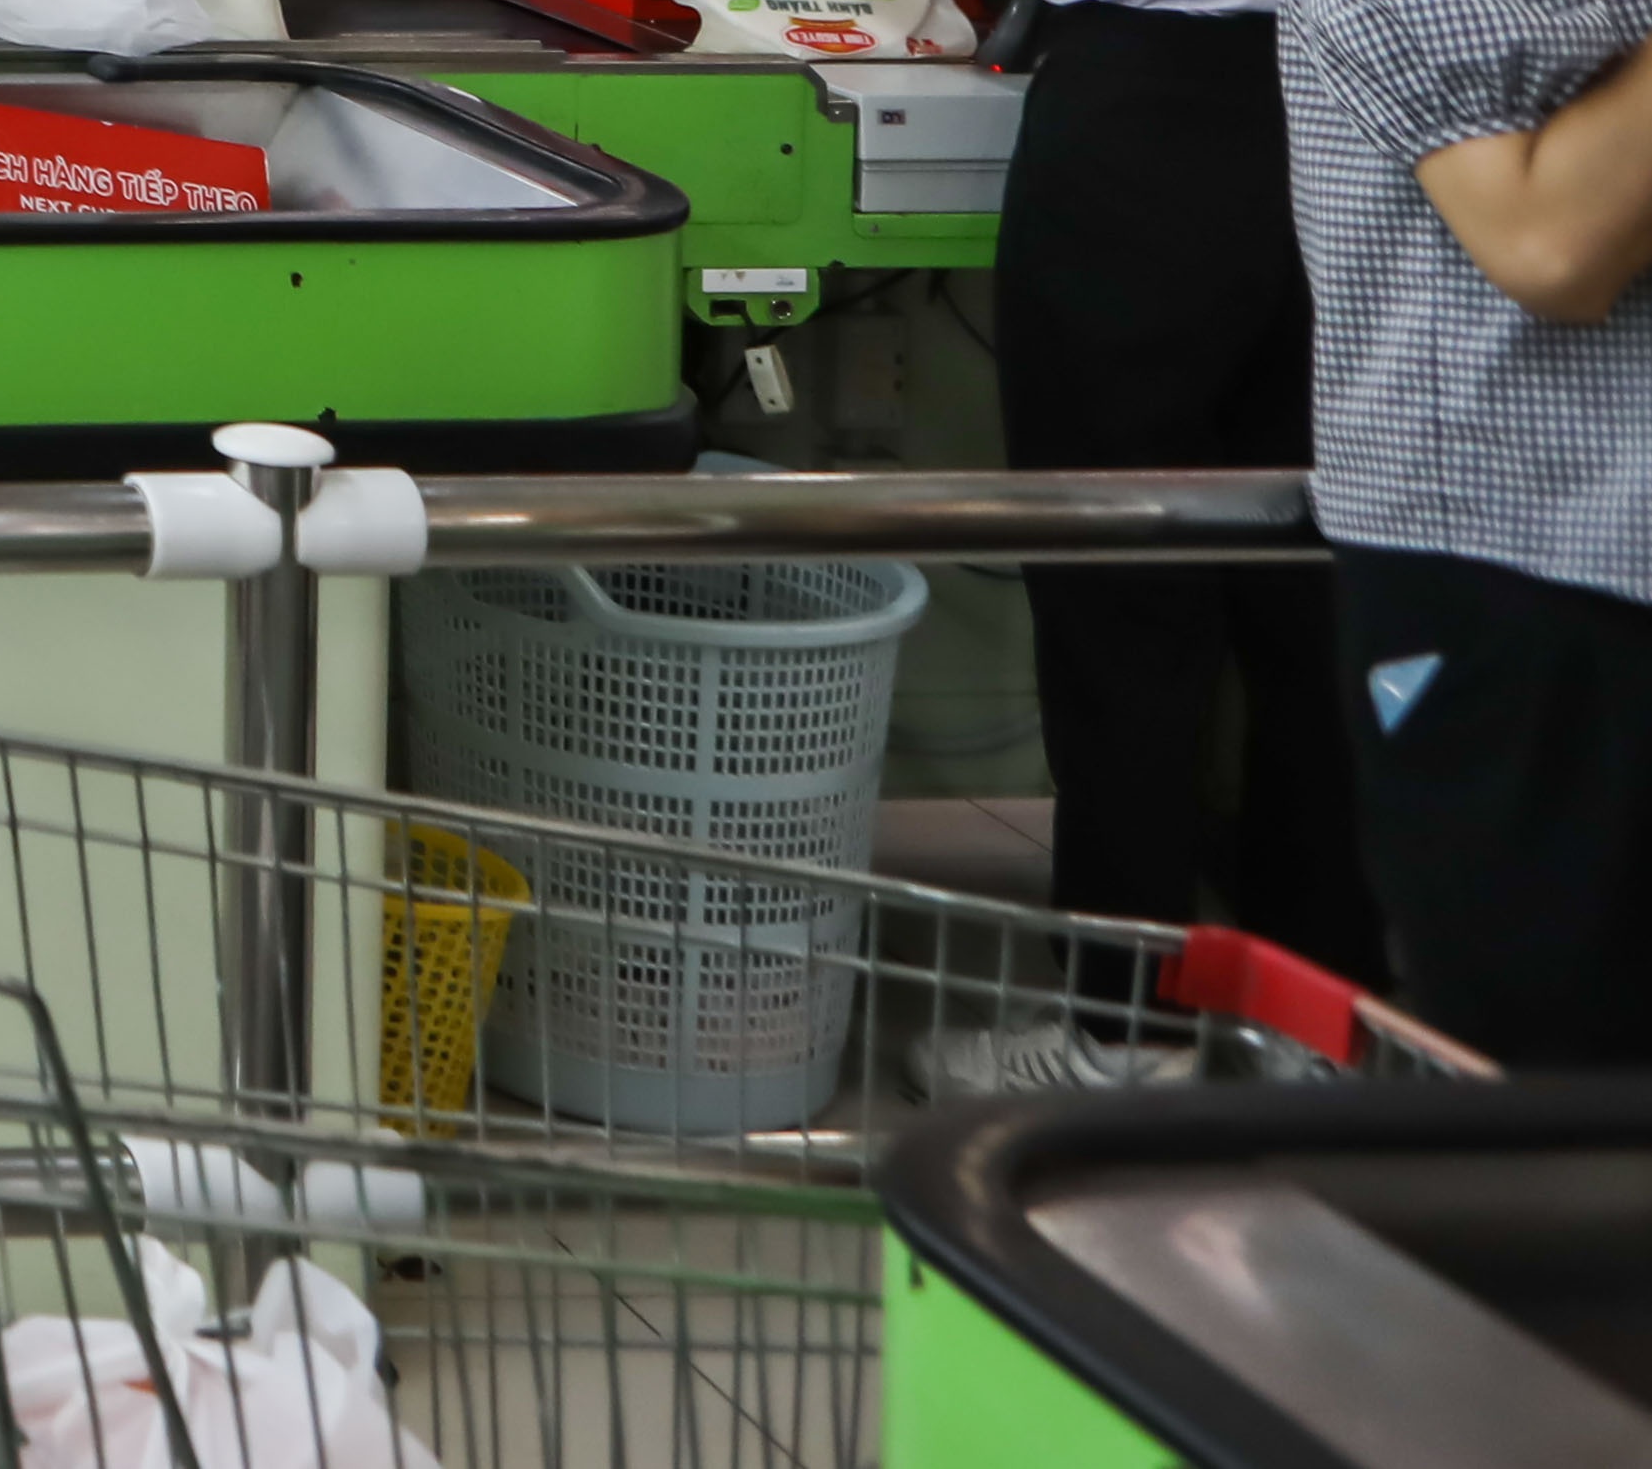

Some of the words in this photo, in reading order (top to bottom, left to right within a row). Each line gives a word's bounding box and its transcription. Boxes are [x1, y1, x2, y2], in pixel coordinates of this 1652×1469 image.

[826, 0, 874, 16] BÁNH
[34, 154, 113, 200] HÀNG
[117, 168, 178, 209] TIẾP
[183, 183, 258, 213] THEO
[20, 193, 73, 213] NEXT
